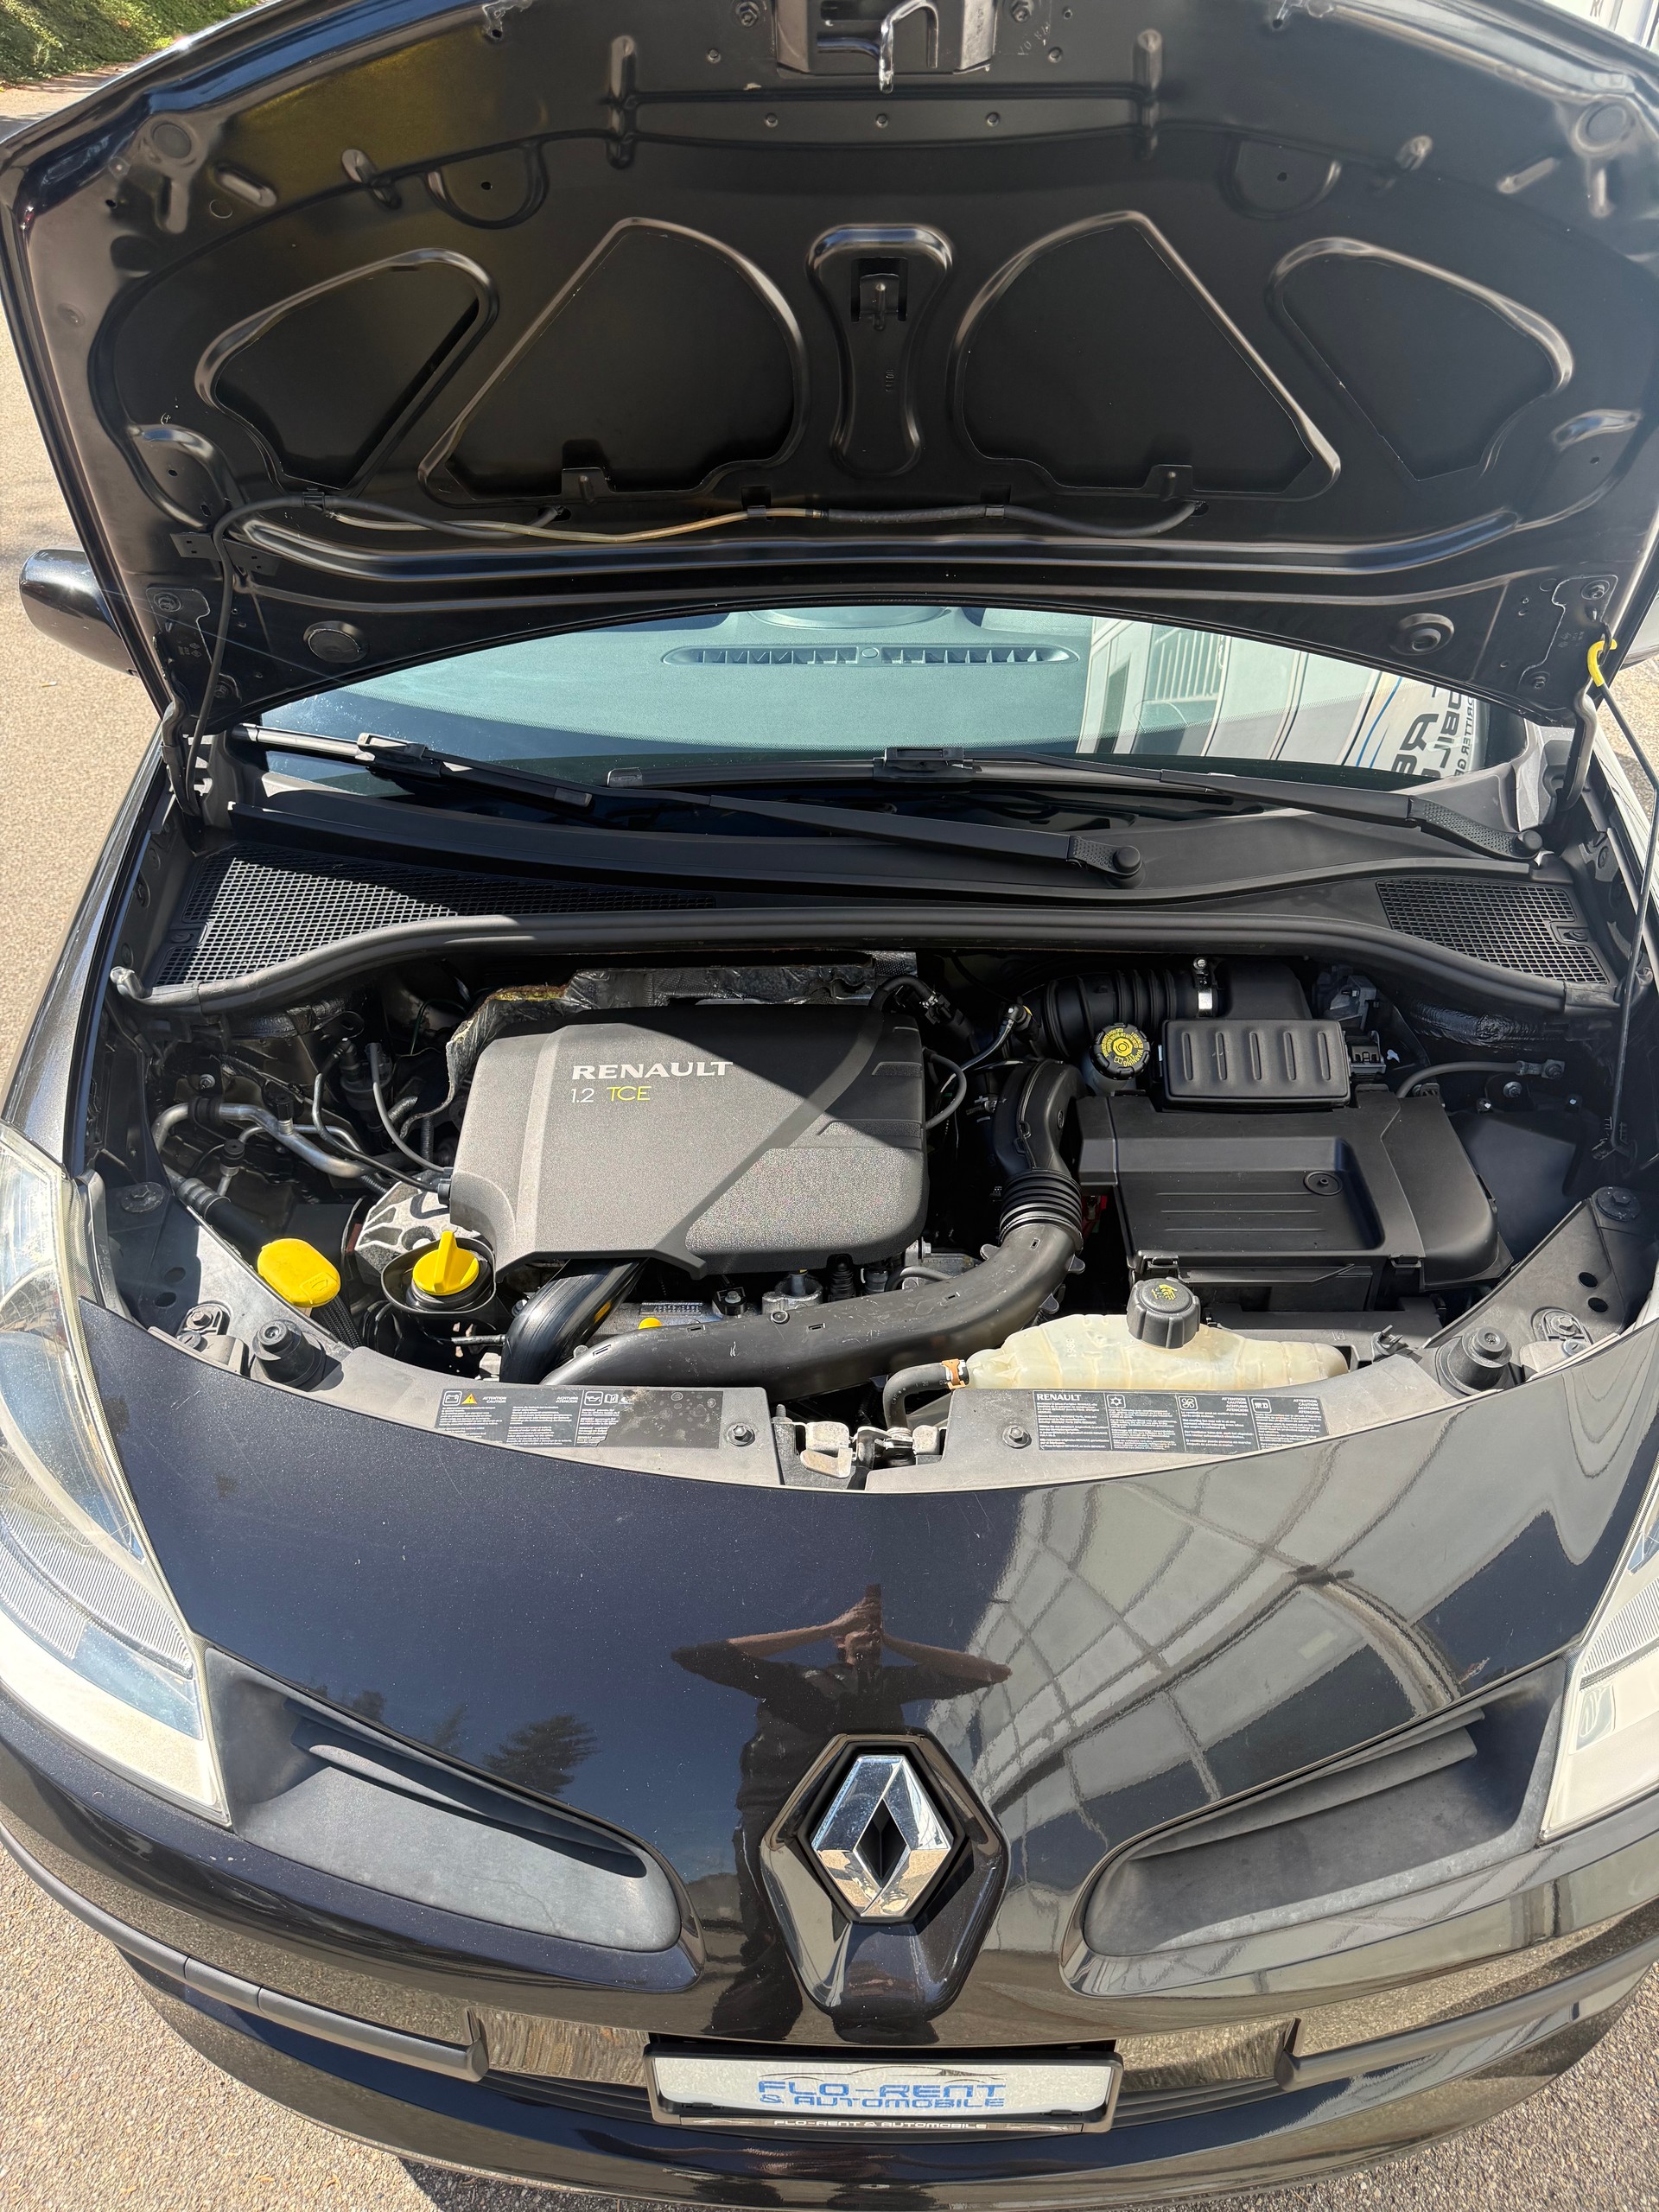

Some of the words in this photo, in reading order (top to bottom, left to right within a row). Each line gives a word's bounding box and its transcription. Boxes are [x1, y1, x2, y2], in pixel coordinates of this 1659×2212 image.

[572, 1061, 733, 1080] RENAULT
[571, 1087, 594, 1103] 1.2
[607, 1086, 652, 1102] TCE
[1036, 1393, 1081, 1402] RENAULT
[758, 2080, 1006, 2098] FLO-RENT
[760, 2094, 785, 2104] &
[794, 2095, 1005, 2108] AUTOMOBILE
